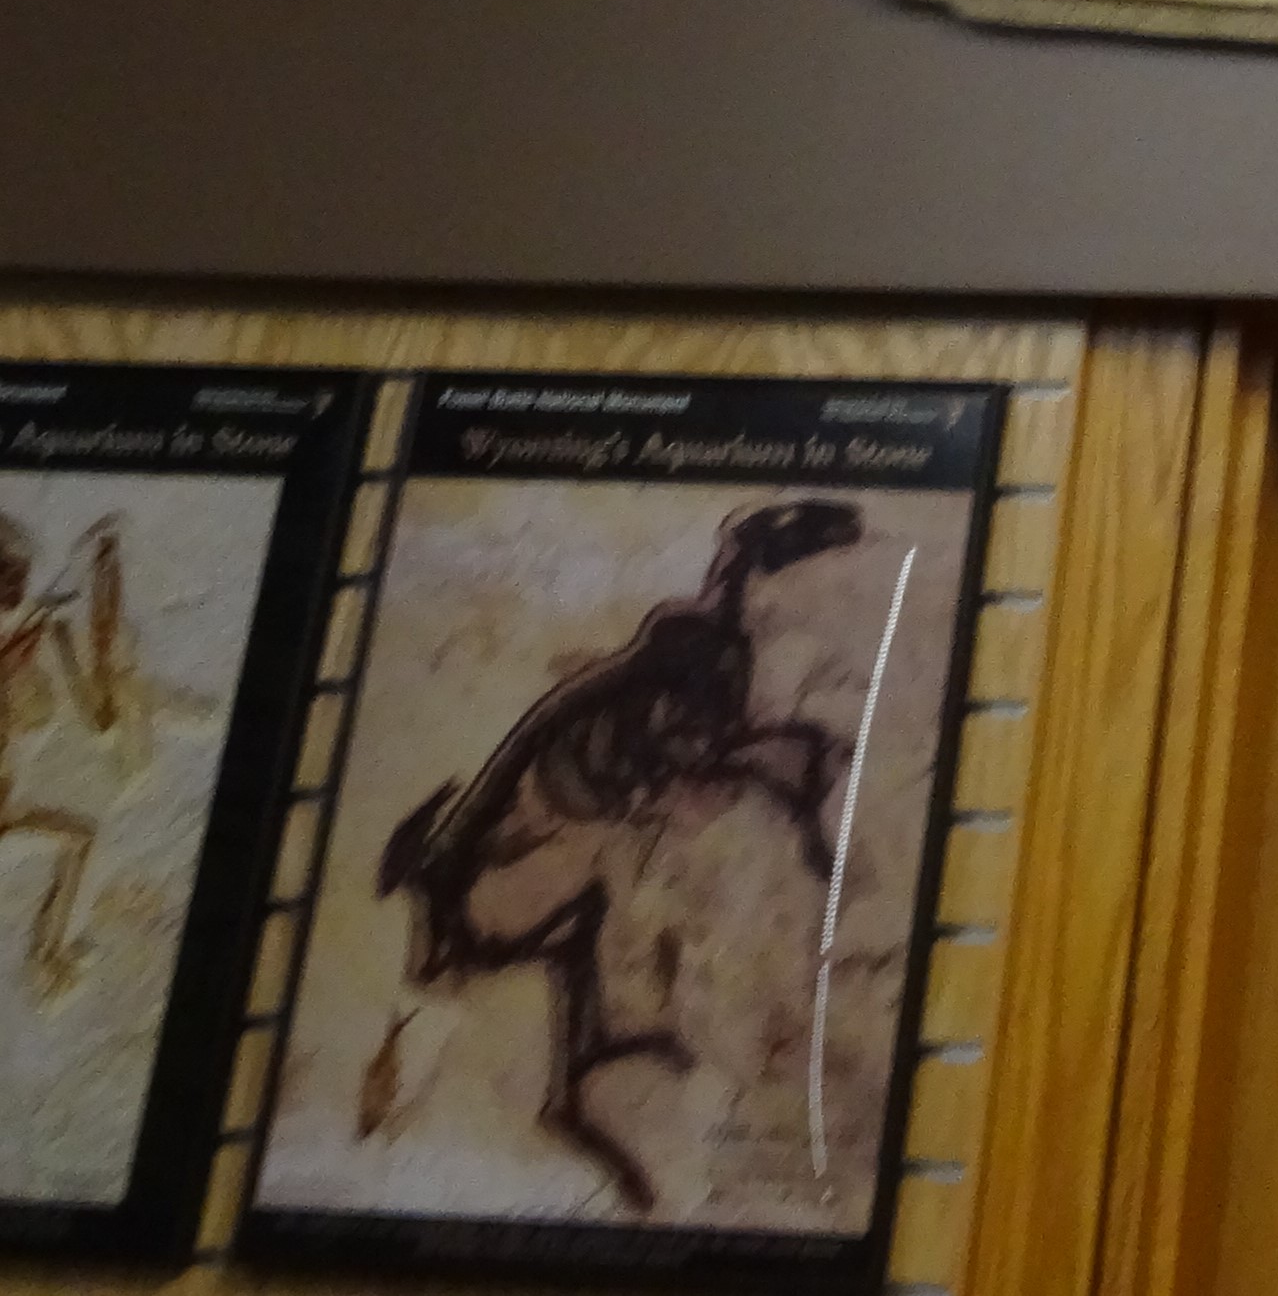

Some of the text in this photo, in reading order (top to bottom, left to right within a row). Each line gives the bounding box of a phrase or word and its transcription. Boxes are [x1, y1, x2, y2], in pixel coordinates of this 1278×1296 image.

[8, 419, 165, 463] Aquarium
[169, 422, 203, 457] in
[459, 425, 934, 475] Wyoming's Aquarium in Stone
